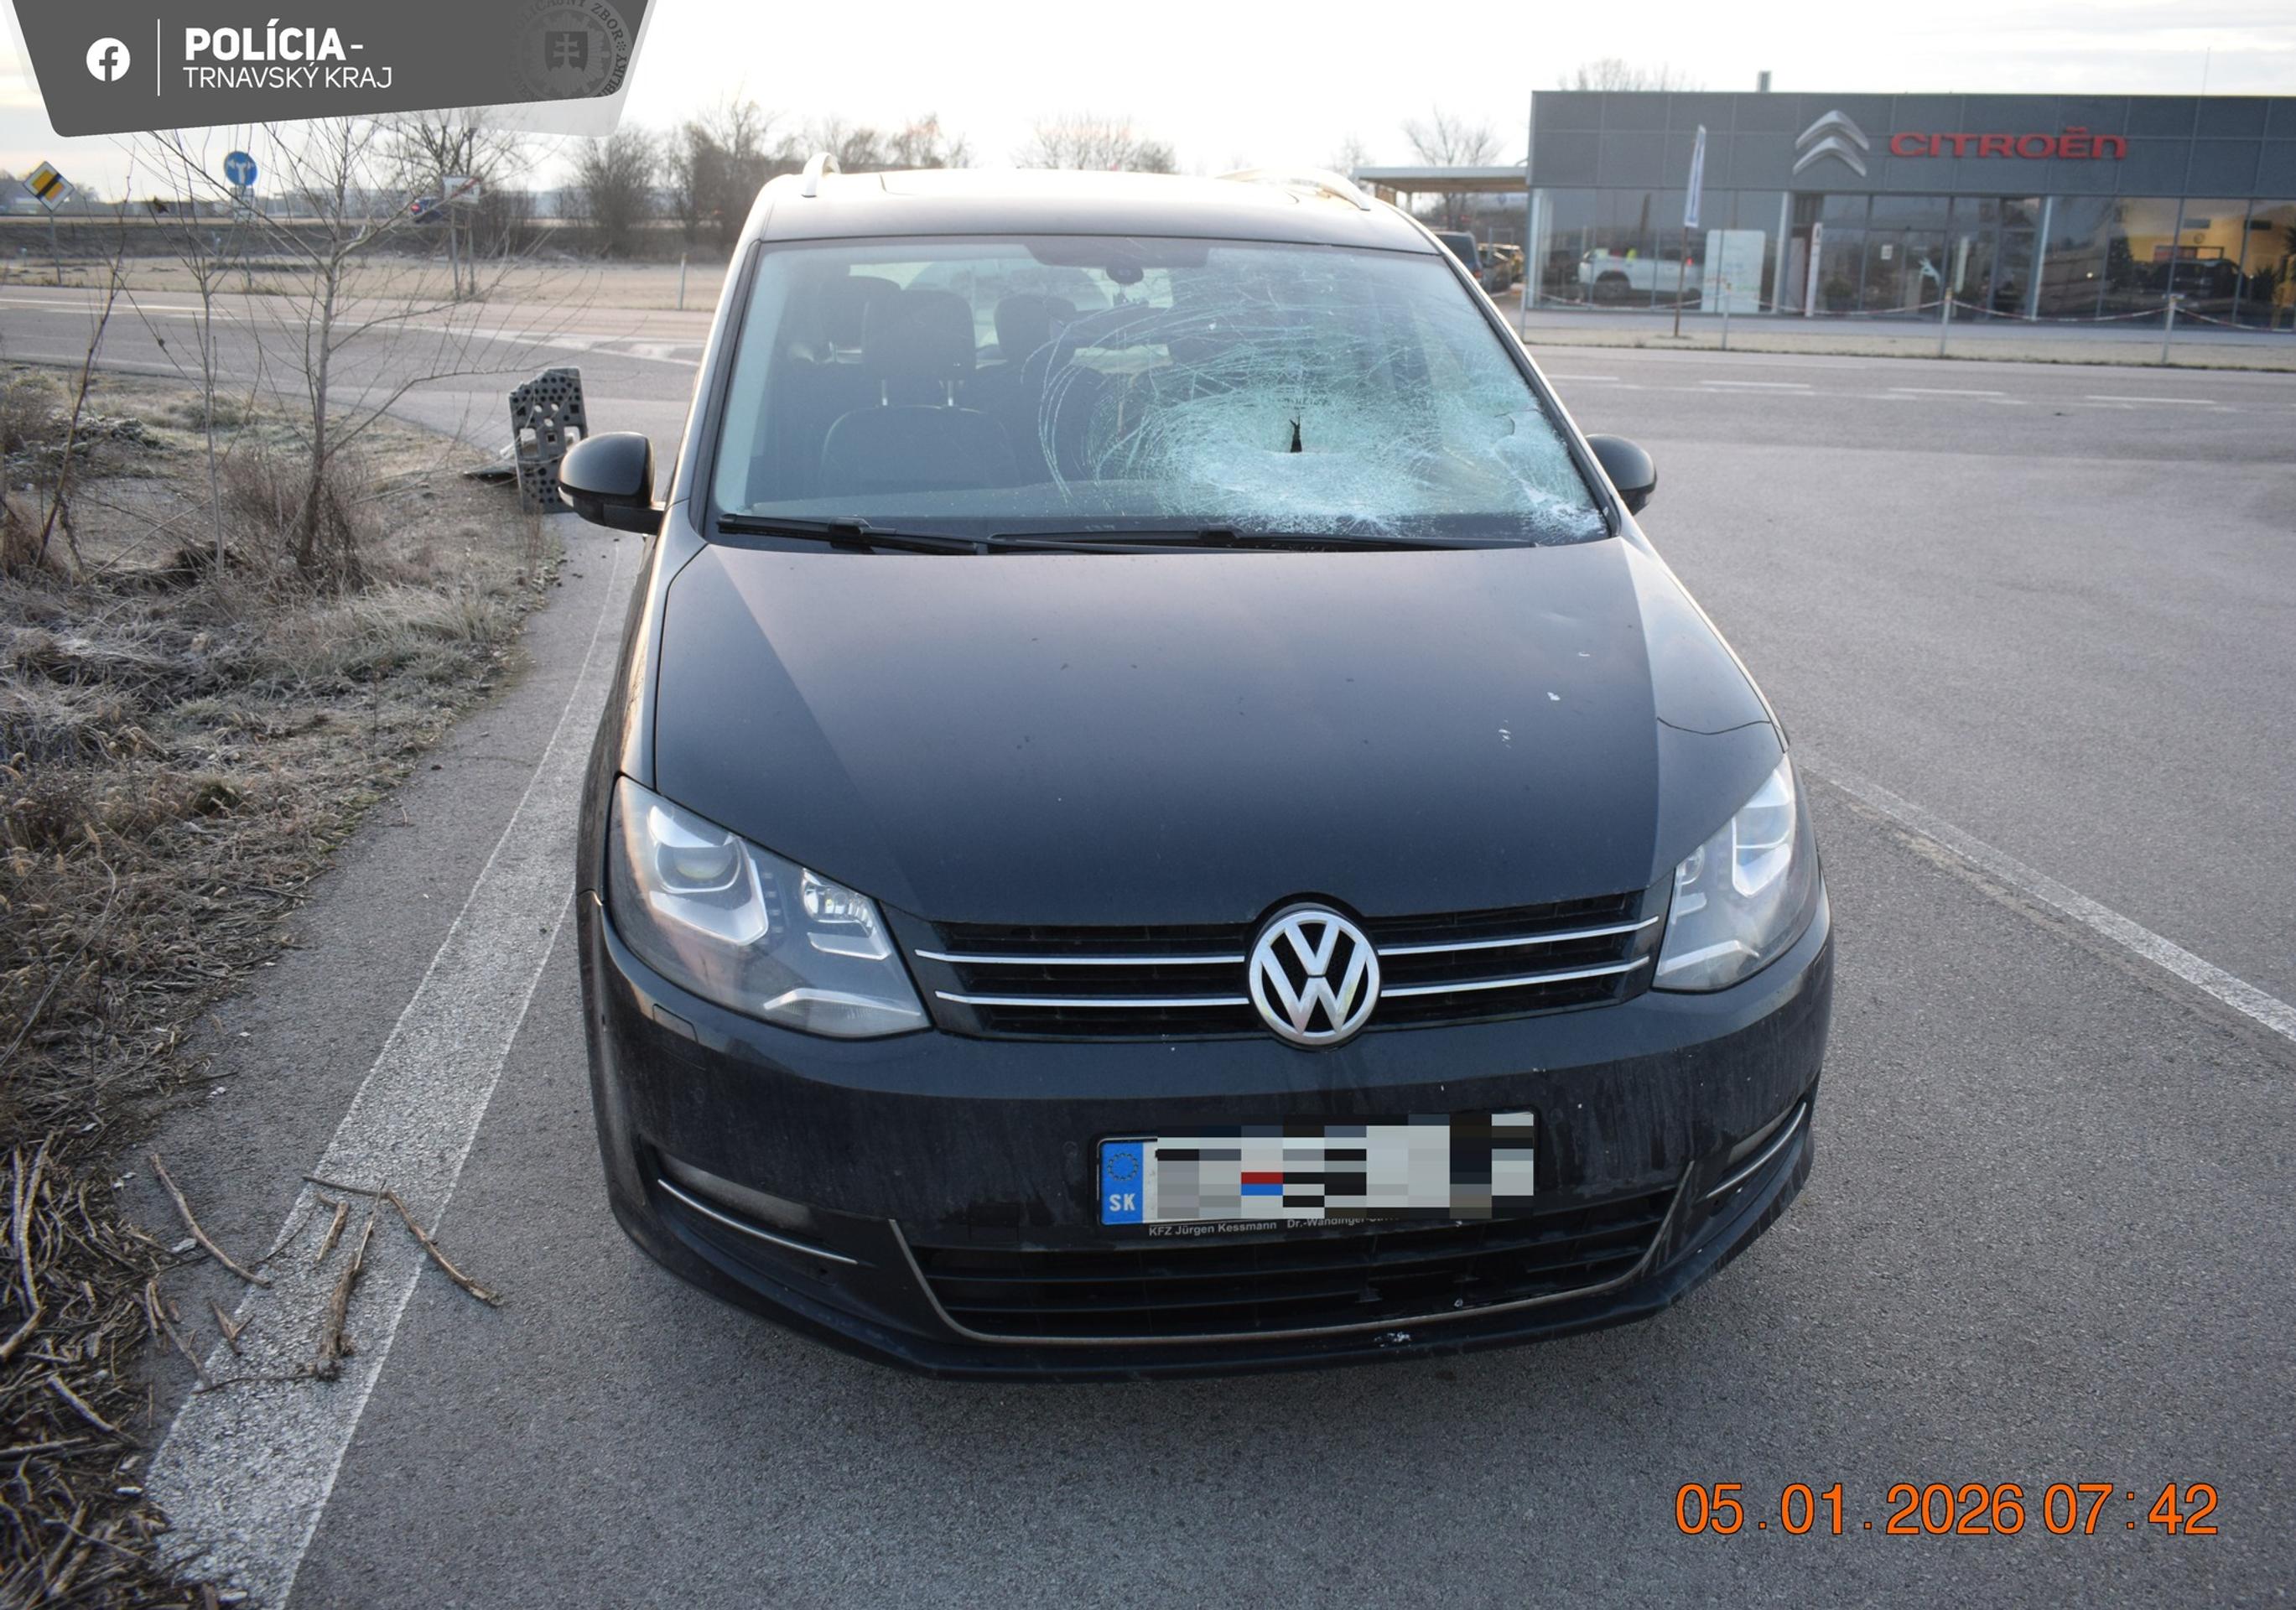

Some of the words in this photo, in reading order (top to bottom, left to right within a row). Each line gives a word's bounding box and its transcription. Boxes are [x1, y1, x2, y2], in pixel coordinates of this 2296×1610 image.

[1109, 1193, 1135, 1212] SK
[1149, 1226, 1172, 1237] KFZ
[1175, 1224, 1214, 1236] Jürgen
[1218, 1221, 1277, 1233] Kessmann
